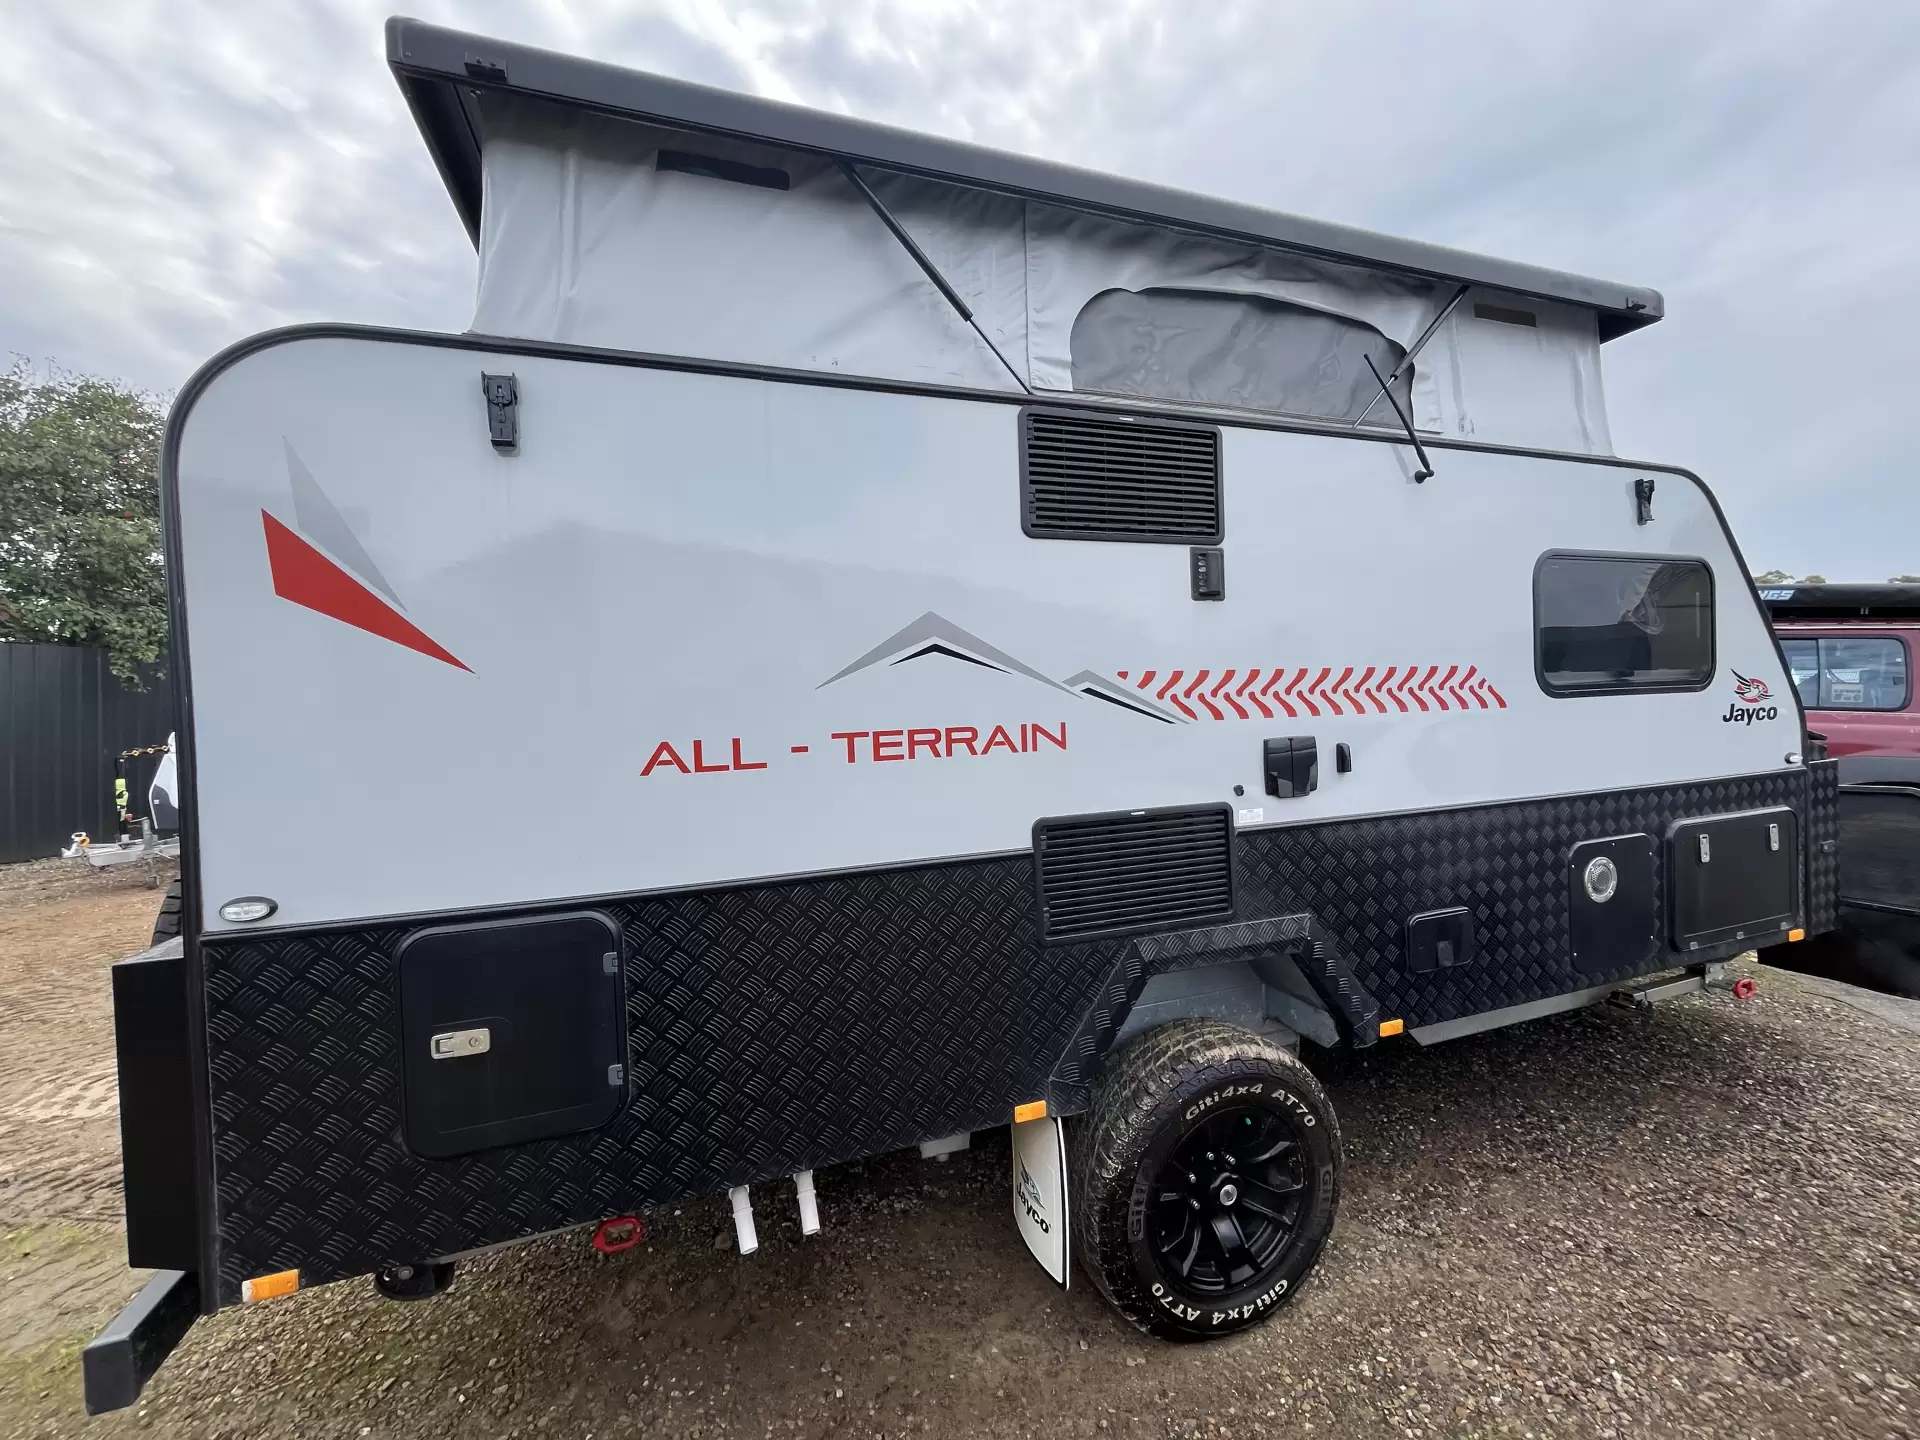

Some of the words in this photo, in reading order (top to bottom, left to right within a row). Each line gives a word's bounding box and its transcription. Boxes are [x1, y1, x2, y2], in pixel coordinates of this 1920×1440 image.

[1722, 703, 1778, 726] Jayco
[639, 738, 768, 777] ALL
[831, 721, 1067, 764] TERRAIN
[1270, 1089, 1316, 1127] AT70
[1016, 1182, 1049, 1234] Jayco
[1151, 1282, 1201, 1322] AT70
